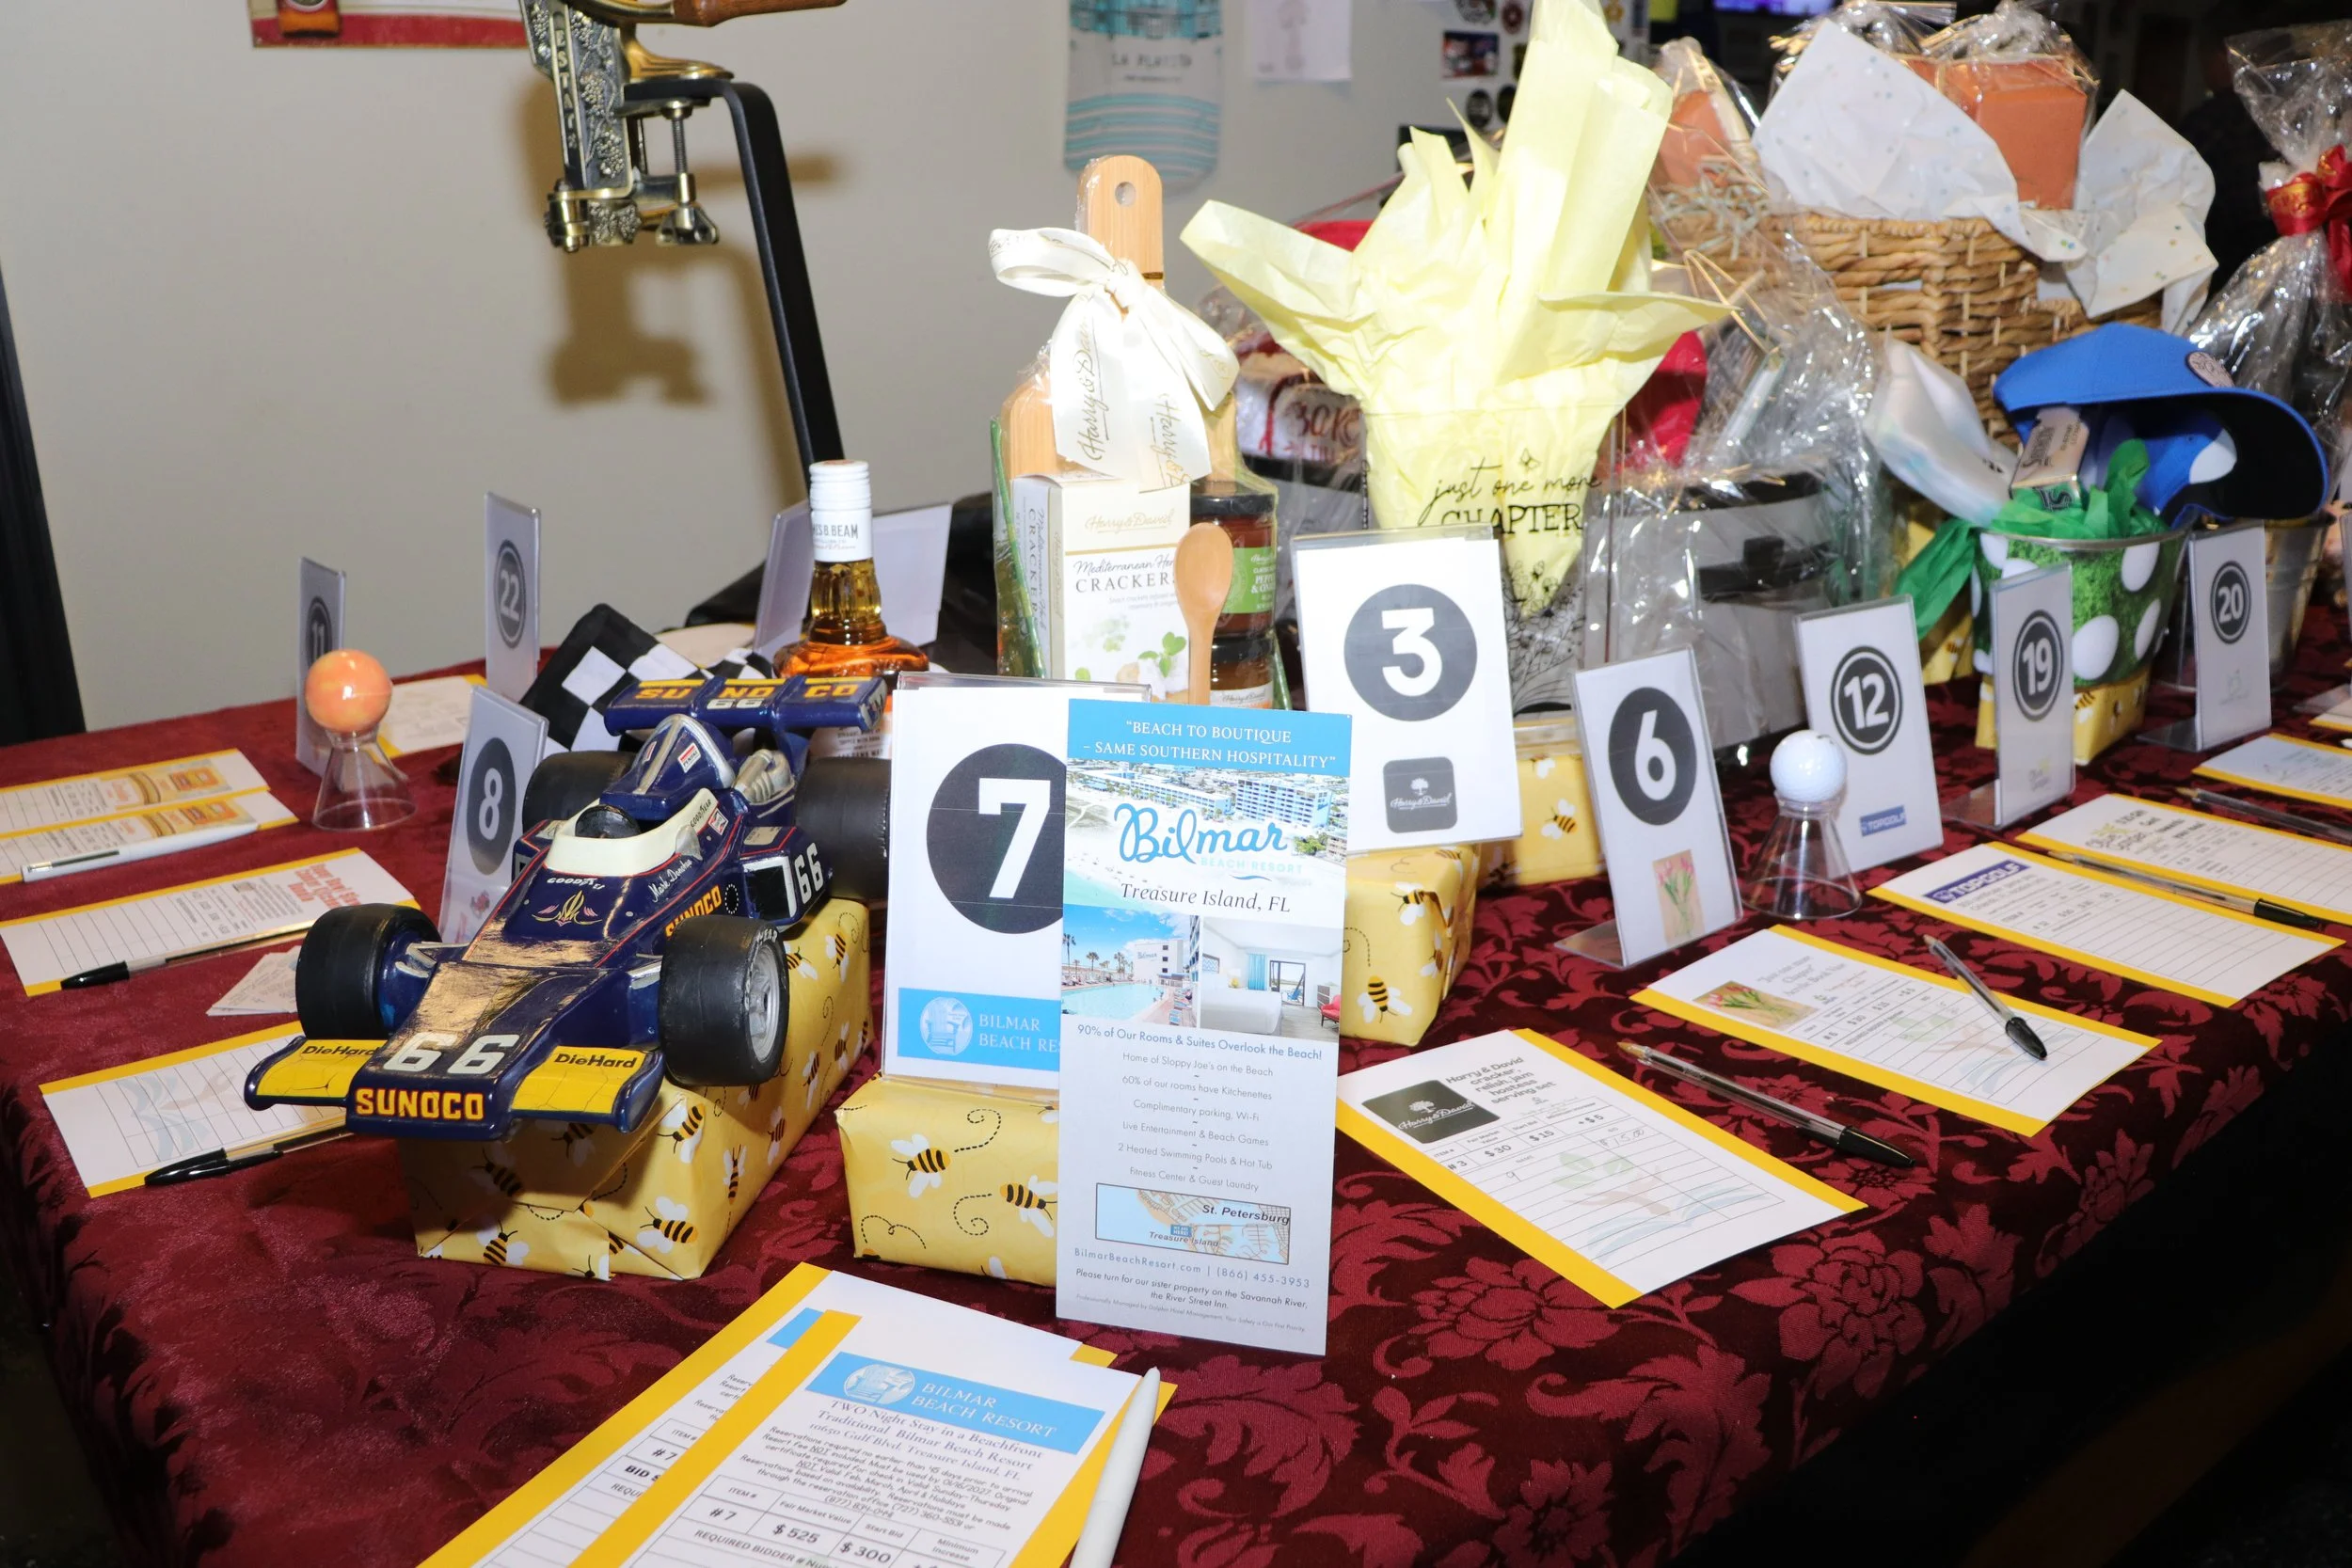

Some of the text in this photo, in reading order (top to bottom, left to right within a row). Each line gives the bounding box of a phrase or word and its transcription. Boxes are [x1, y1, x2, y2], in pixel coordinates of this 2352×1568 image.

[1418, 456, 1602, 527] just one more
[832, 524, 859, 539] BEAM
[1073, 553, 1174, 576] Mediterranean Her
[497, 569, 521, 622] 22
[1075, 571, 1175, 594] CRACKER
[2217, 584, 2245, 623] 20
[1381, 607, 1443, 698] 3
[2022, 637, 2053, 696] 19
[635, 688, 693, 700] SU
[706, 699, 764, 709] 66
[1844, 673, 1890, 729] 12
[1186, 724, 1208, 738] TO
[1212, 726, 1292, 744] BOUTIQUE
[1095, 741, 1136, 755] SAME
[1139, 745, 1222, 761] SOUTHERN
[1634, 710, 1678, 802] 6
[477, 768, 506, 841] 8
[690, 799, 712, 828] GOODYEAR
[978, 777, 1051, 899] 7
[1114, 802, 1288, 864] Bilmar
[794, 843, 824, 905] 66
[1200, 857, 1303, 875] BEACH RESORT
[648, 874, 670, 903] Mark
[1120, 882, 1291, 912] Treasure Island, FL
[665, 884, 723, 937] SNOCO
[979, 1014, 1041, 1032] BILMAR
[302, 1044, 378, 1058] DieHard
[384, 1033, 519, 1074] 66
[979, 1033, 1060, 1053] BEACH RE
[1077, 1024, 1322, 1060] 90% of Our Rooms & Suites Overlook the Beach!
[554, 1053, 638, 1069] DieHard
[1122, 1053, 1148, 1063] Home
[1151, 1053, 1160, 1065] of
[1162, 1055, 1192, 1069] Sloppy
[1194, 1060, 1214, 1070] Joe's
[1231, 1064, 1243, 1073] the
[1246, 1065, 1274, 1076] Beach
[1446, 1056, 1524, 1085] Harry & David
[1122, 1075, 1273, 1101] 60% of our rooms have Kitchenettes
[1489, 1079, 1537, 1097] hostess
[1491, 1082, 1557, 1104] serving set
[1511, 1072, 1534, 1085] jam
[356, 1087, 485, 1121] SUNOCO
[1133, 1099, 1260, 1121] Complimentary parking, Wi-Fi
[1122, 1121, 1269, 1146] Live Entertainment & Beach Games
[1118, 1143, 1273, 1170] 2 Heated Swimming Pools & Hot Tub
[1130, 1166, 1156, 1178] Fitness
[1158, 1171, 1186, 1182] Center
[1199, 1176, 1223, 1187] Guest
[1226, 1179, 1259, 1193] Laundry
[1202, 1204, 1290, 1226] St. Petersburg
[1150, 1231, 1219, 1247] Treasure Island
[1074, 1248, 1310, 1289] BilmarBeachResort.com (866) 455-3953
[1075, 1268, 1102, 1279] Please
[1104, 1273, 1120, 1282] turn
[1121, 1275, 1134, 1284] for
[1152, 1280, 1171, 1289] sister
[1174, 1284, 1209, 1296] property
[1225, 1289, 1237, 1298] the
[1240, 1291, 1282, 1305] Savannah
[1284, 1297, 1308, 1309] River,
[1151, 1291, 1229, 1309] the River Street Inn.
[921, 1382, 998, 1408] BILMAR
[831, 1400, 867, 1415] TWO
[869, 1409, 908, 1425] Night
[909, 1418, 938, 1434] Stay
[941, 1427, 954, 1437] in
[968, 1433, 1044, 1459] Beachfront
[911, 1395, 1057, 1438] BEACH RESORT
[809, 1423, 841, 1435] 10650
[907, 1445, 959, 1465] Treasure
[1004, 1469, 1020, 1481] FL
[818, 1410, 1035, 1470] Traditional Bilmar Beach Resort
[625, 1465, 650, 1479] BID
[728, 1486, 749, 1497] ITEM
[798, 1504, 827, 1518] Market
[829, 1513, 852, 1525] Value
[866, 1523, 886, 1535] Start
[888, 1529, 904, 1539] Bid
[937, 1538, 979, 1555] Minimum
[694, 1529, 795, 1562] REQUIRED BIDDER
[787, 1527, 820, 1544] 525
[854, 1545, 892, 1564] 300
[931, 1545, 970, 1561] Increase
